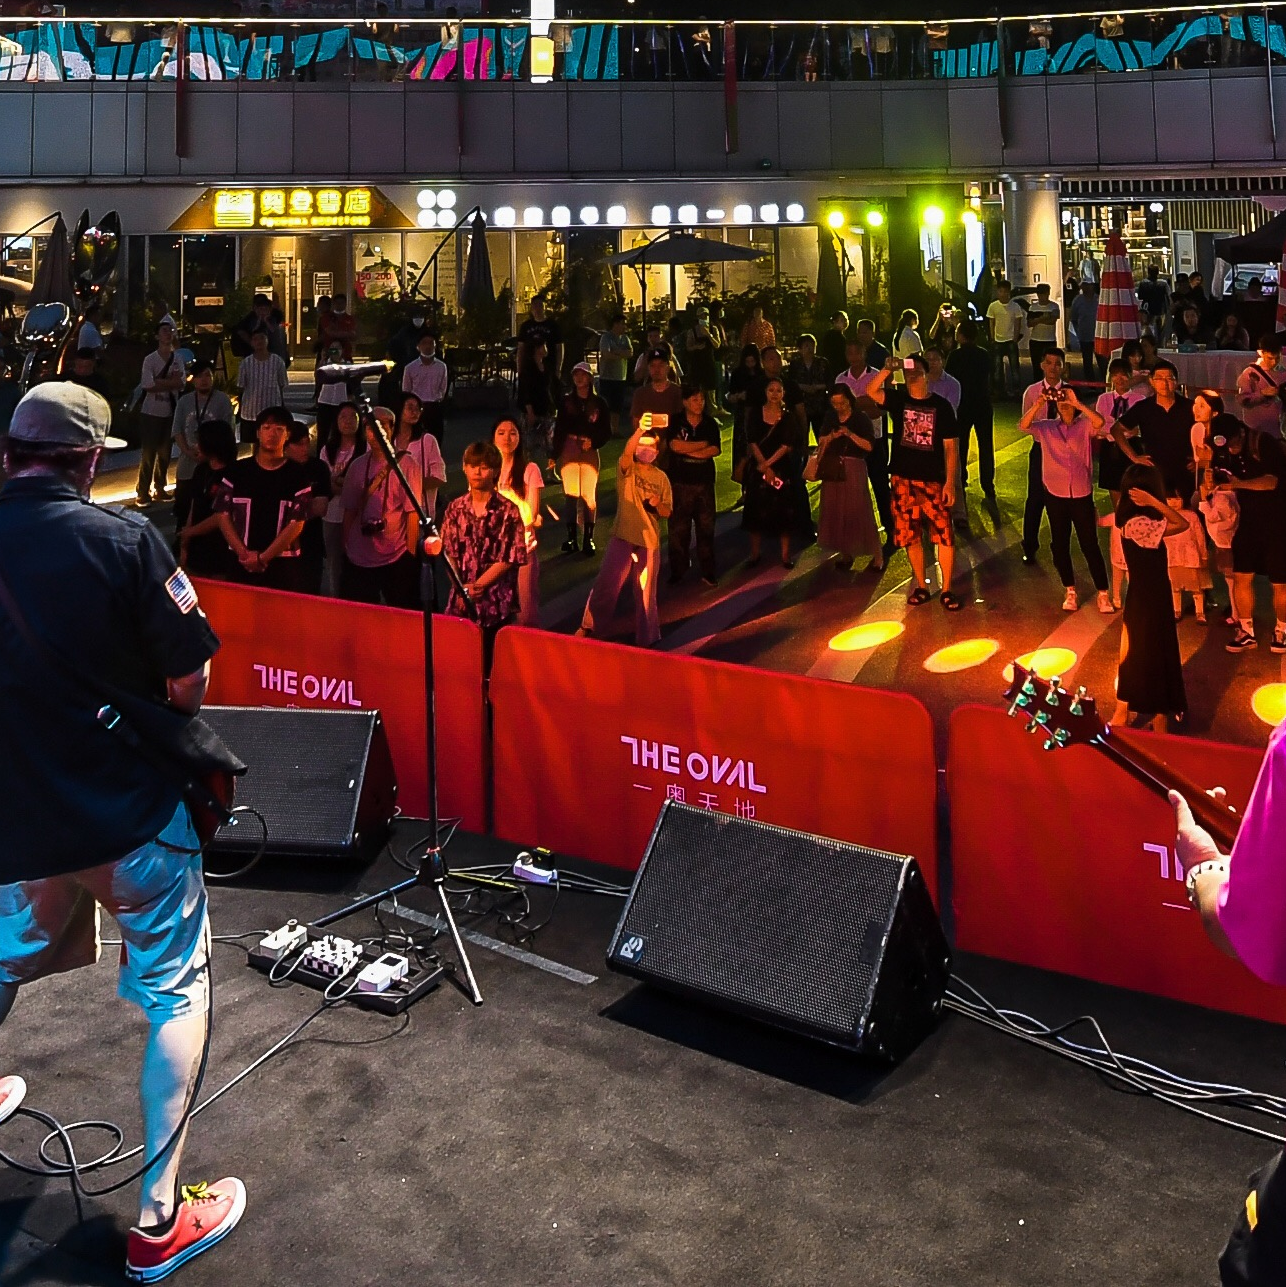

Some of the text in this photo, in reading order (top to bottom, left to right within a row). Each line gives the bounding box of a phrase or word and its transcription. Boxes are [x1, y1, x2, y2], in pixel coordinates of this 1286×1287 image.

[253, 664, 362, 707] THE OVAL
[620, 735, 767, 794] THE OVAL
